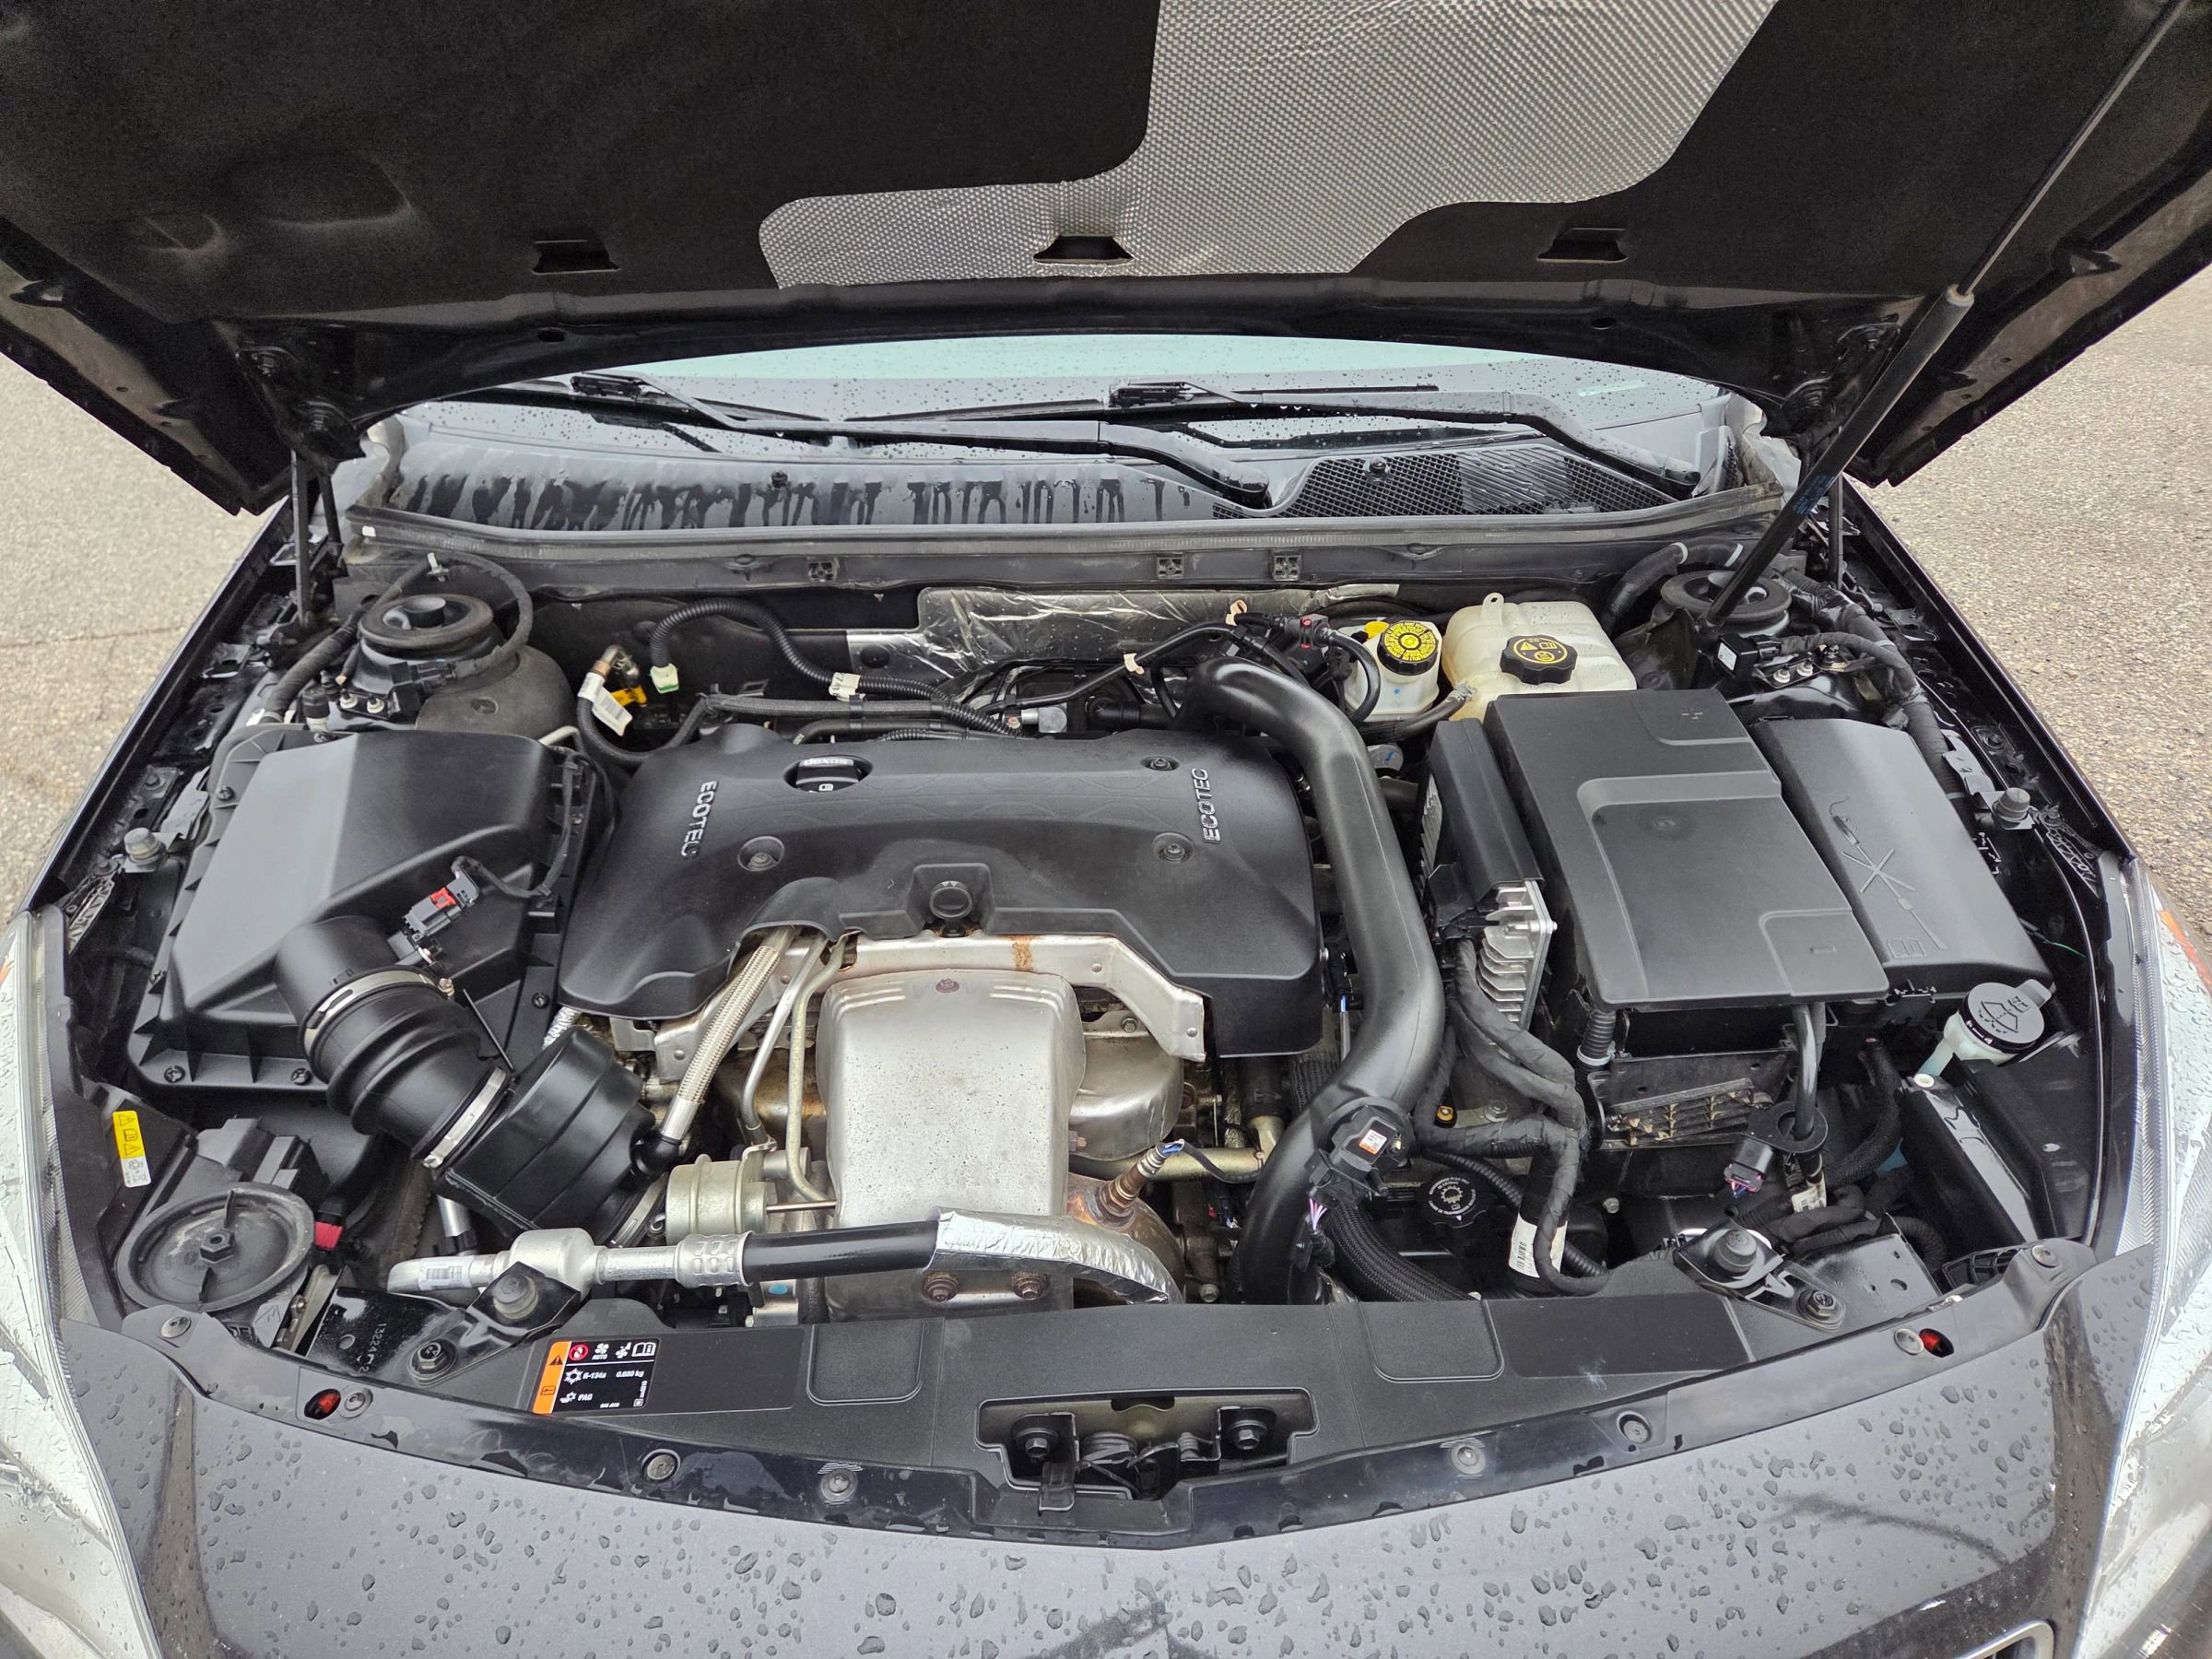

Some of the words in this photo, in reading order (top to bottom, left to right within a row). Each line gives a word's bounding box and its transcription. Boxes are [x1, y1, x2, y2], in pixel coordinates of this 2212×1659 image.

[680, 781, 718, 857] ECOTEC
[1191, 768, 1221, 842] ECOTEC
[635, 1370, 645, 1378] kg
[577, 1394, 594, 1402] PAG
